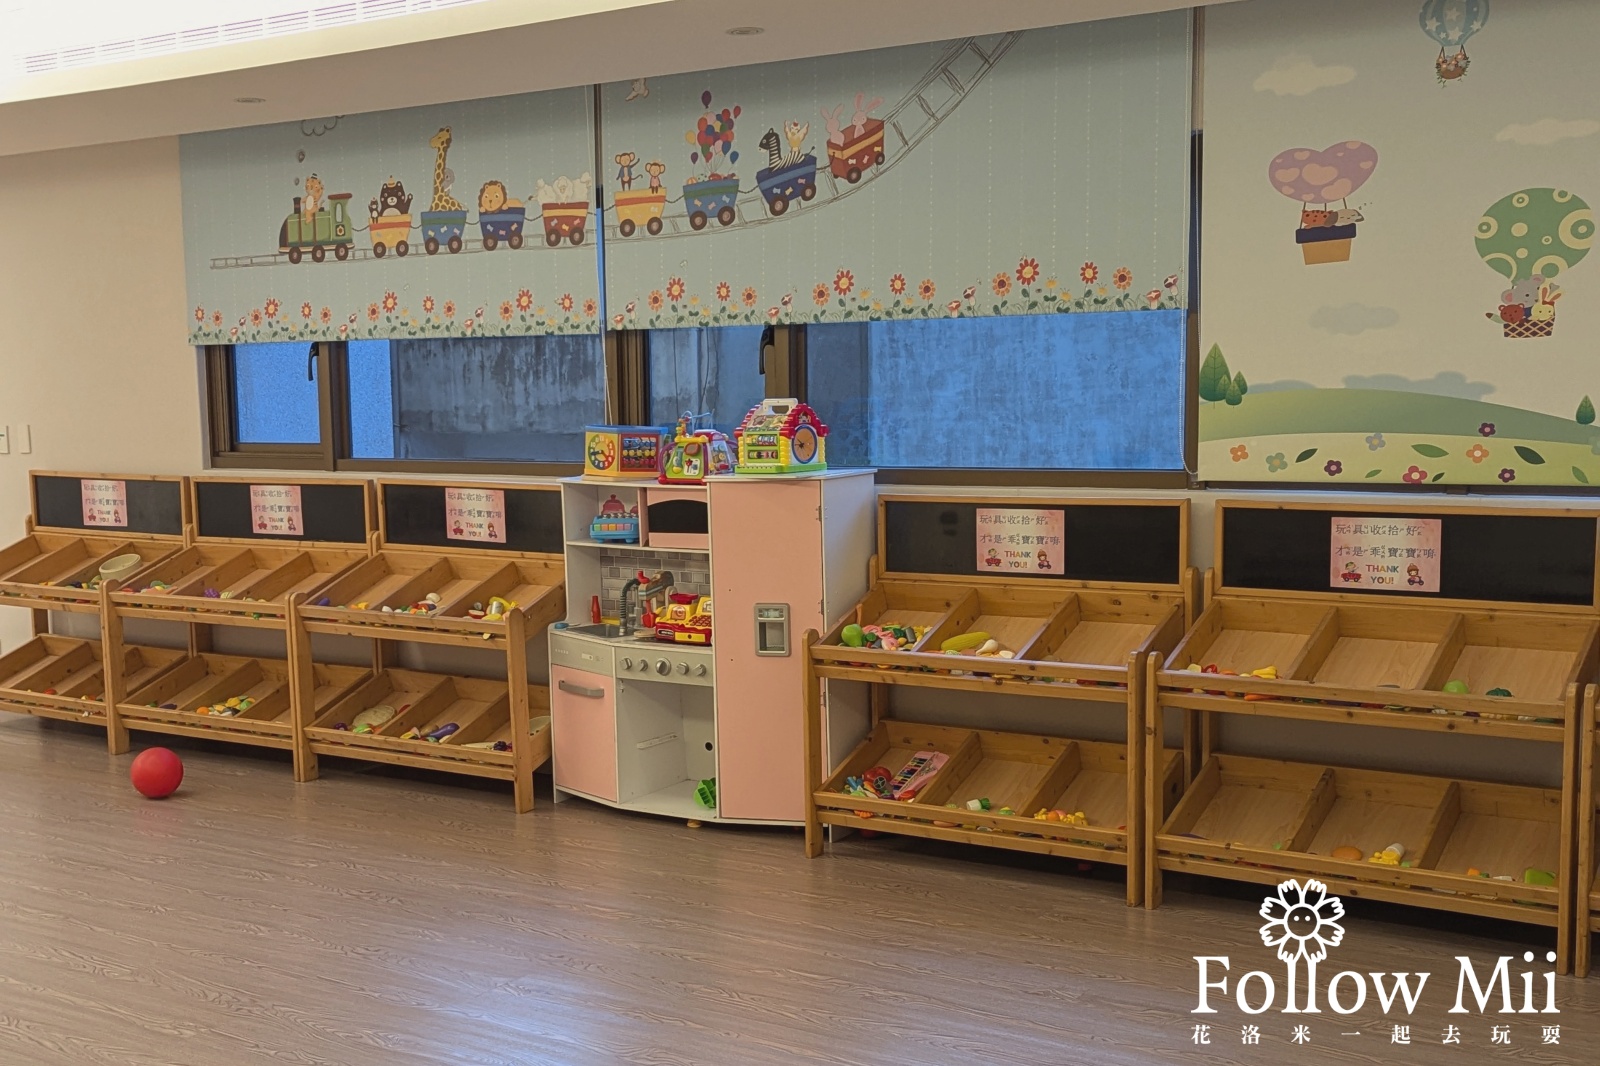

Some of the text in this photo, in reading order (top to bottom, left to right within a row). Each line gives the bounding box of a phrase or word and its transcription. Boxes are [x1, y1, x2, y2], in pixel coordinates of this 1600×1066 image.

[979, 514, 1050, 525] 玩具收拾好
[1335, 523, 1422, 537] 玩具收拾好
[1004, 550, 1032, 558] THANK
[1008, 560, 1028, 568] YOU!
[1366, 564, 1400, 573] THANK
[1370, 576, 1394, 584] YOU!
